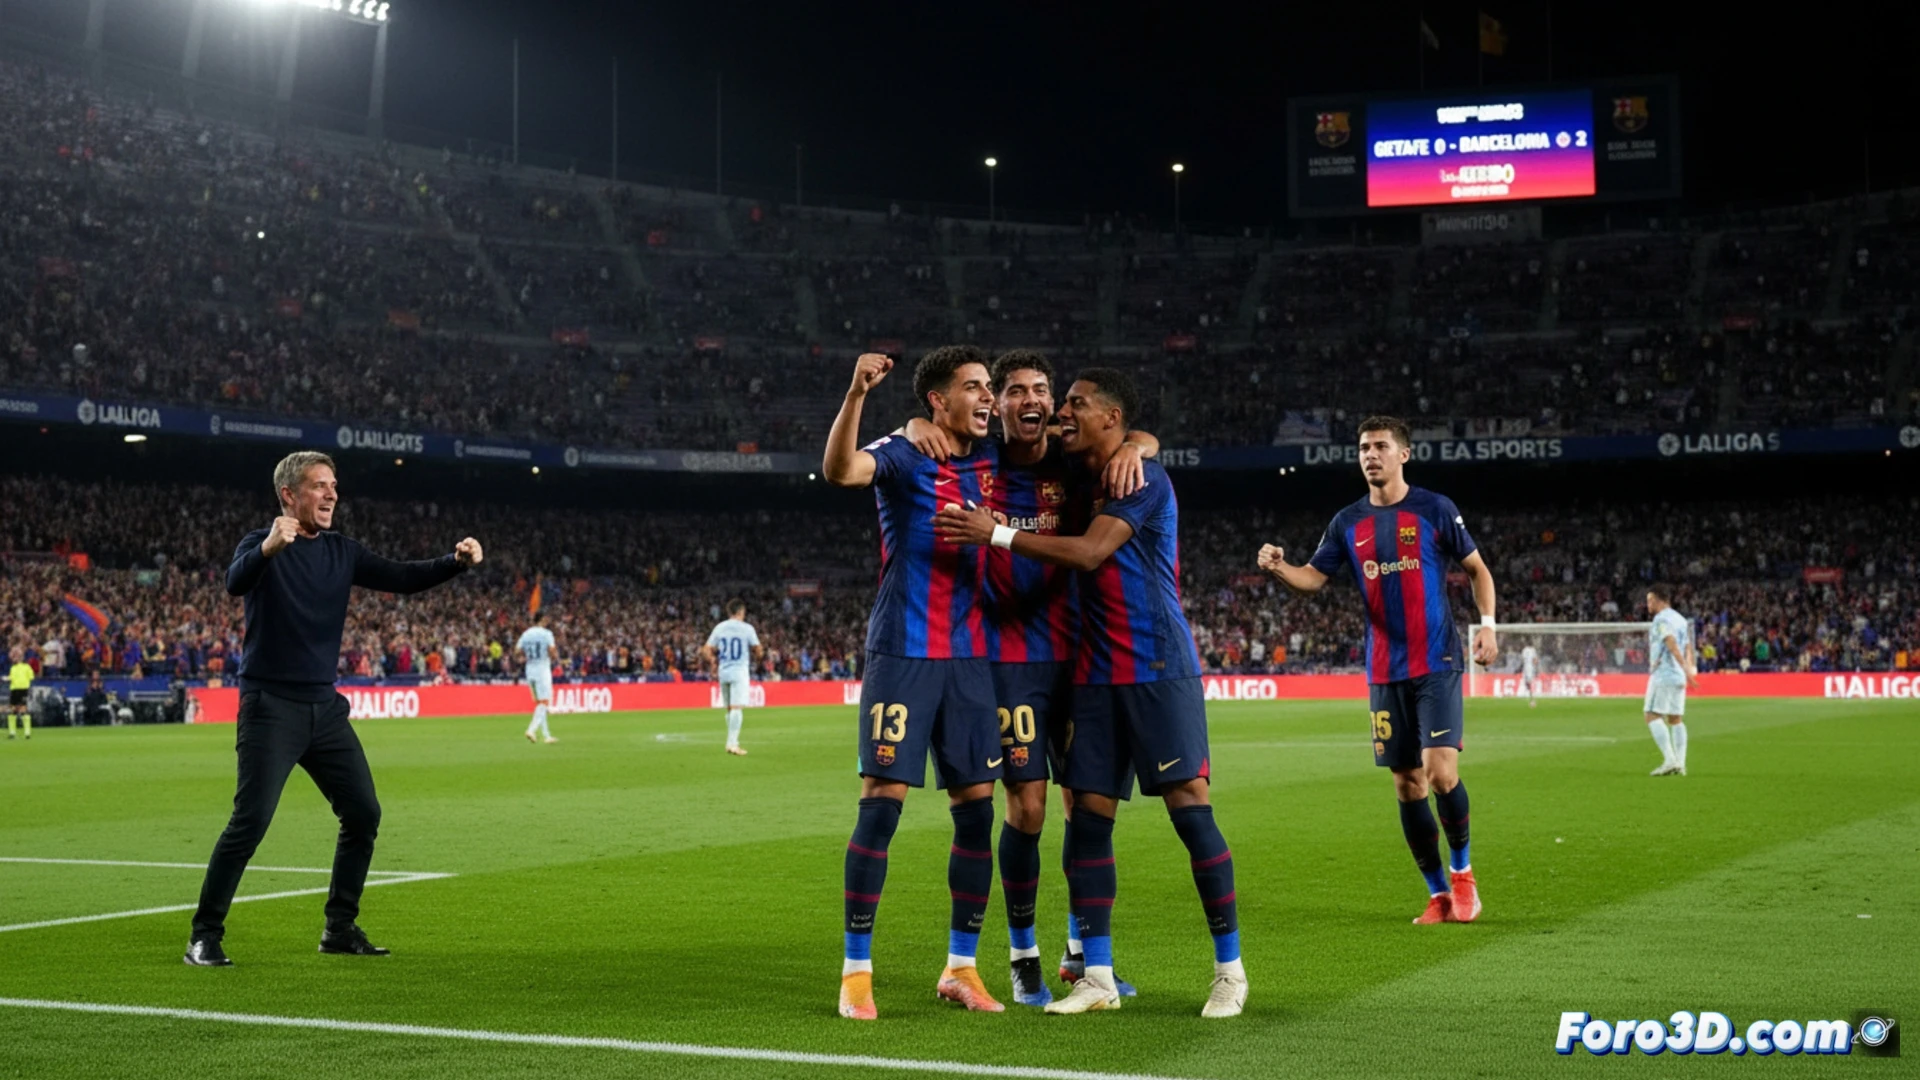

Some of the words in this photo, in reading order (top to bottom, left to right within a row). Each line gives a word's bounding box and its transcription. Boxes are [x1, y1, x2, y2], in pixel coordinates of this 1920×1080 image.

[1373, 138, 1430, 158] GETAFE
[1459, 132, 1550, 153] BARCELONA
[1575, 130, 1588, 147] 2
[1440, 441, 1472, 461] EA
[1475, 439, 1562, 460] SPORTS
[1684, 433, 1764, 453] LALIGA
[870, 702, 908, 743] 13
[997, 704, 1037, 746] 20
